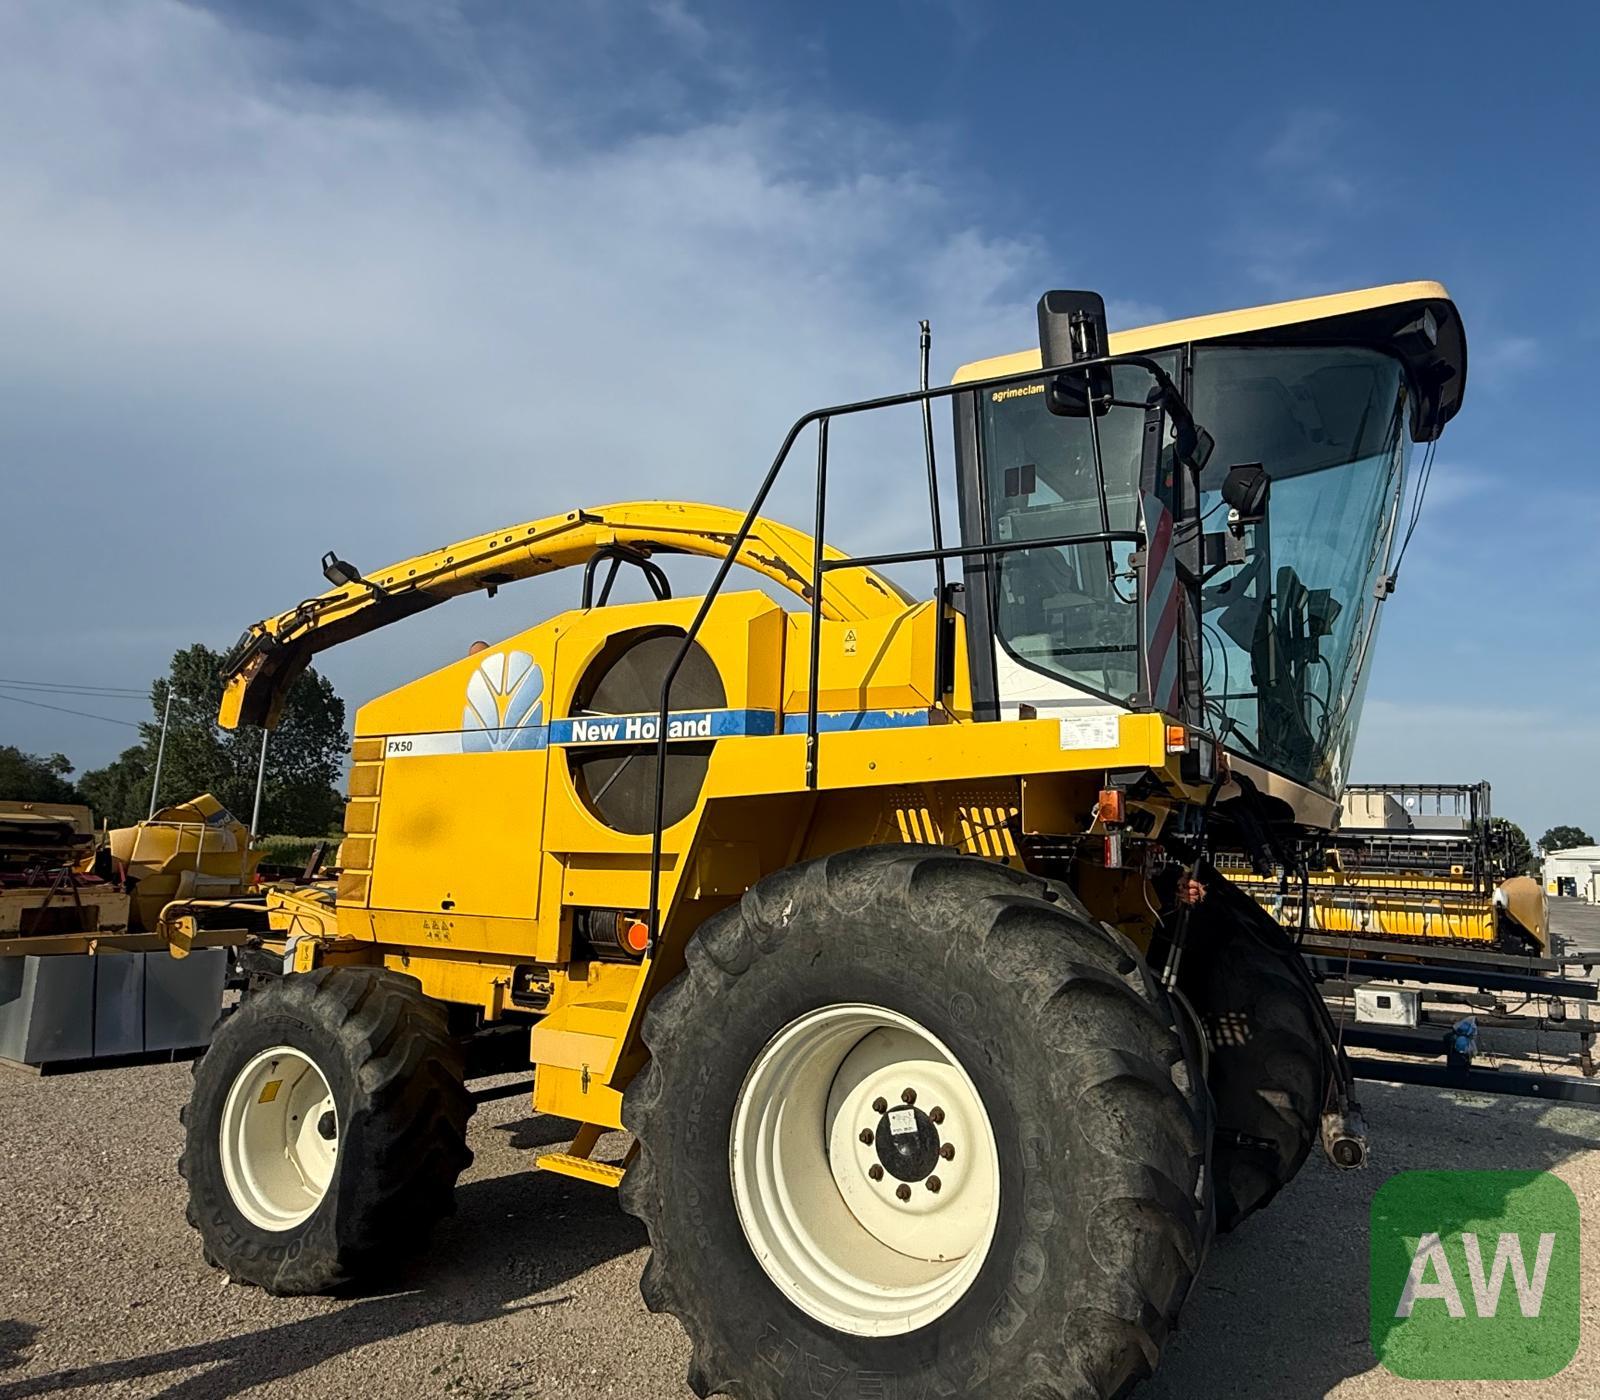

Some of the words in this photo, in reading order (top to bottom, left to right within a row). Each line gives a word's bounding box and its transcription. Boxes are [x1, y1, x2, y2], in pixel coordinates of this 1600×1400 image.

[992, 384, 1045, 402] agrimeclam
[572, 720, 619, 742] New
[626, 714, 712, 740] Holand
[388, 741, 413, 753] FX50
